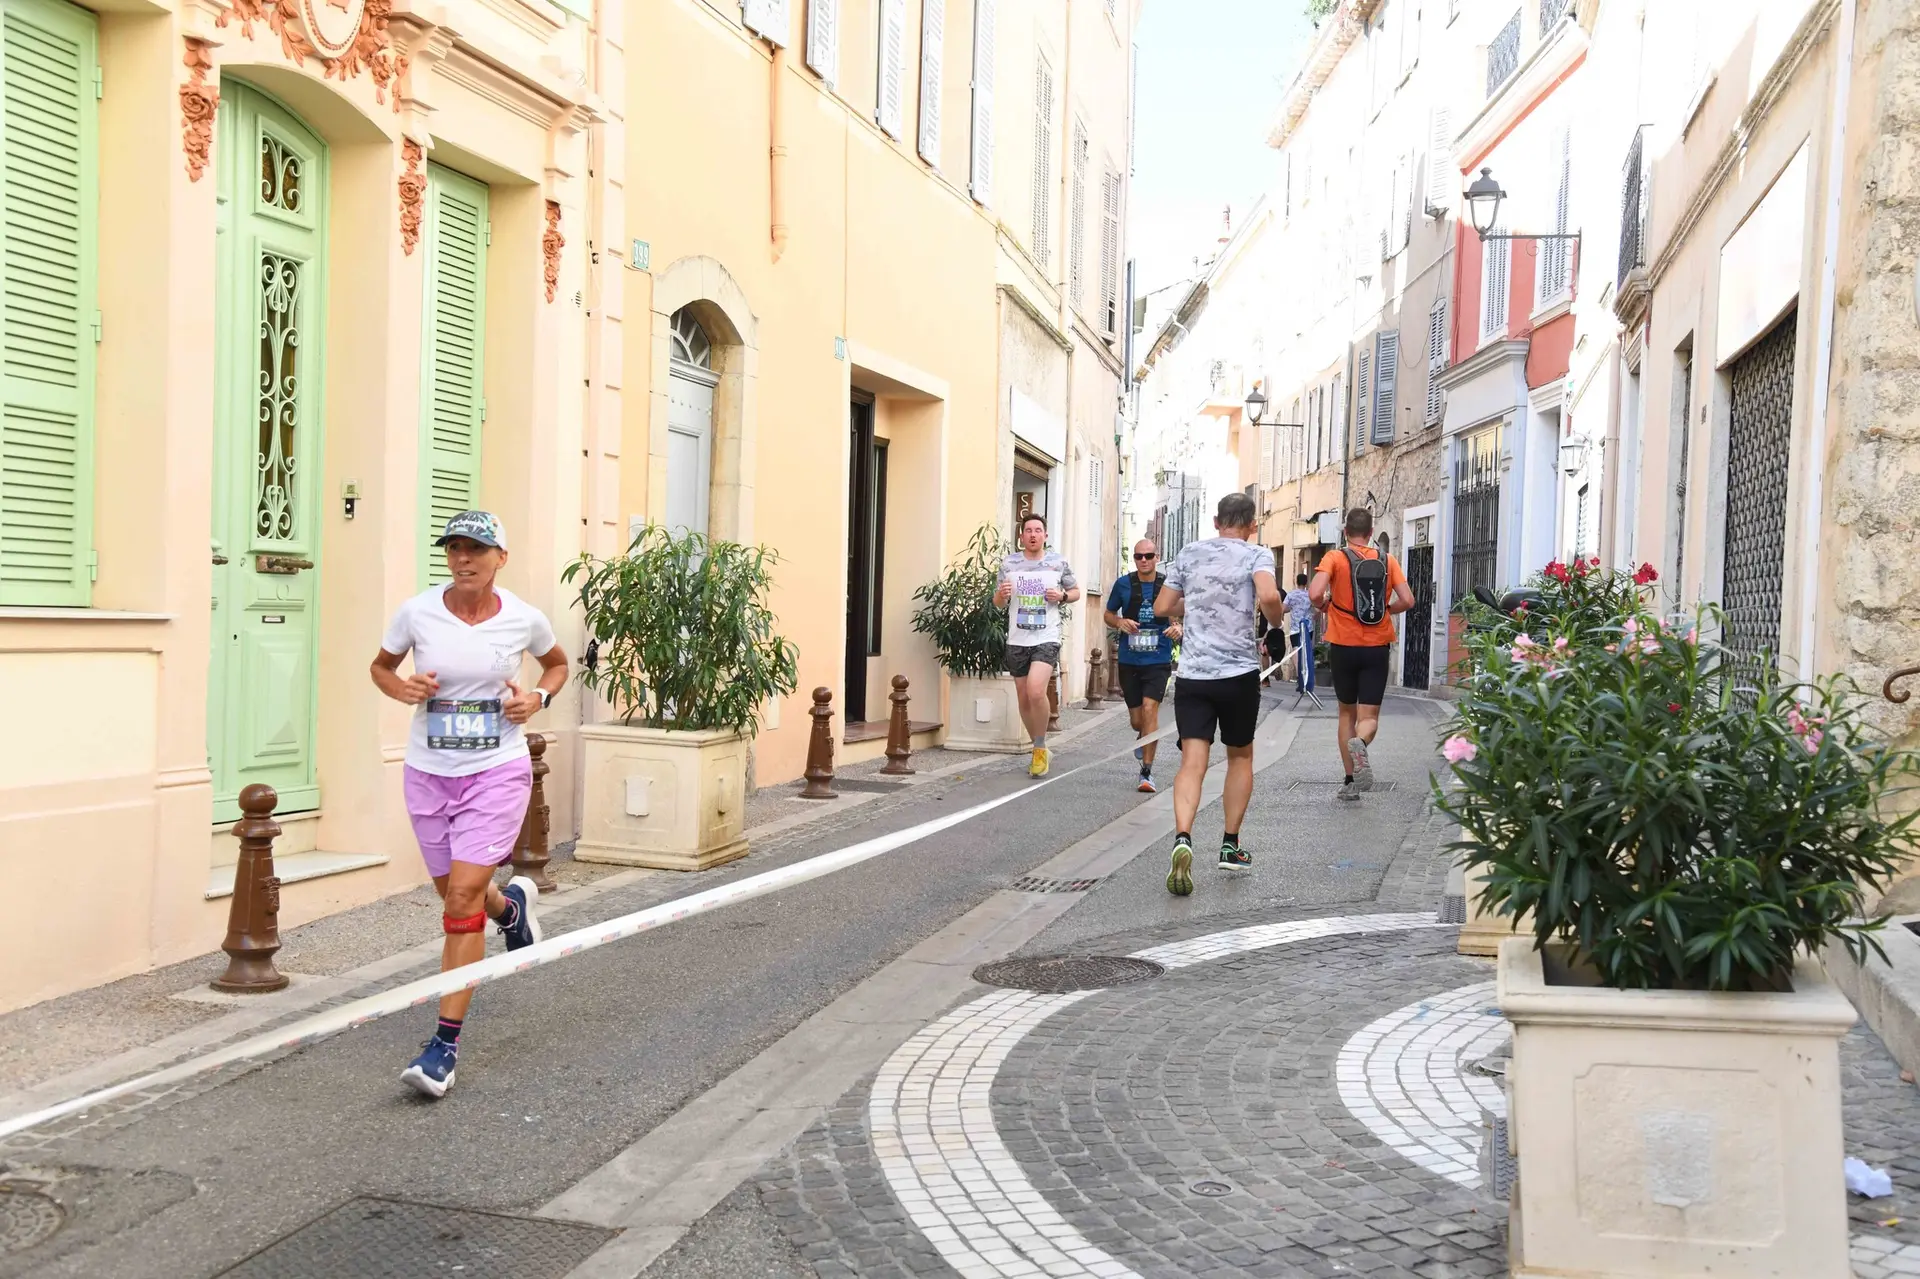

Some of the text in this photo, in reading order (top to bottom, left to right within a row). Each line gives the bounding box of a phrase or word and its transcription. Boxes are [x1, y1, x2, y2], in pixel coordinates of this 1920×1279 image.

[1135, 635, 1152, 646] 141
[458, 705, 482, 713] TRAIL
[442, 714, 486, 737] 194
